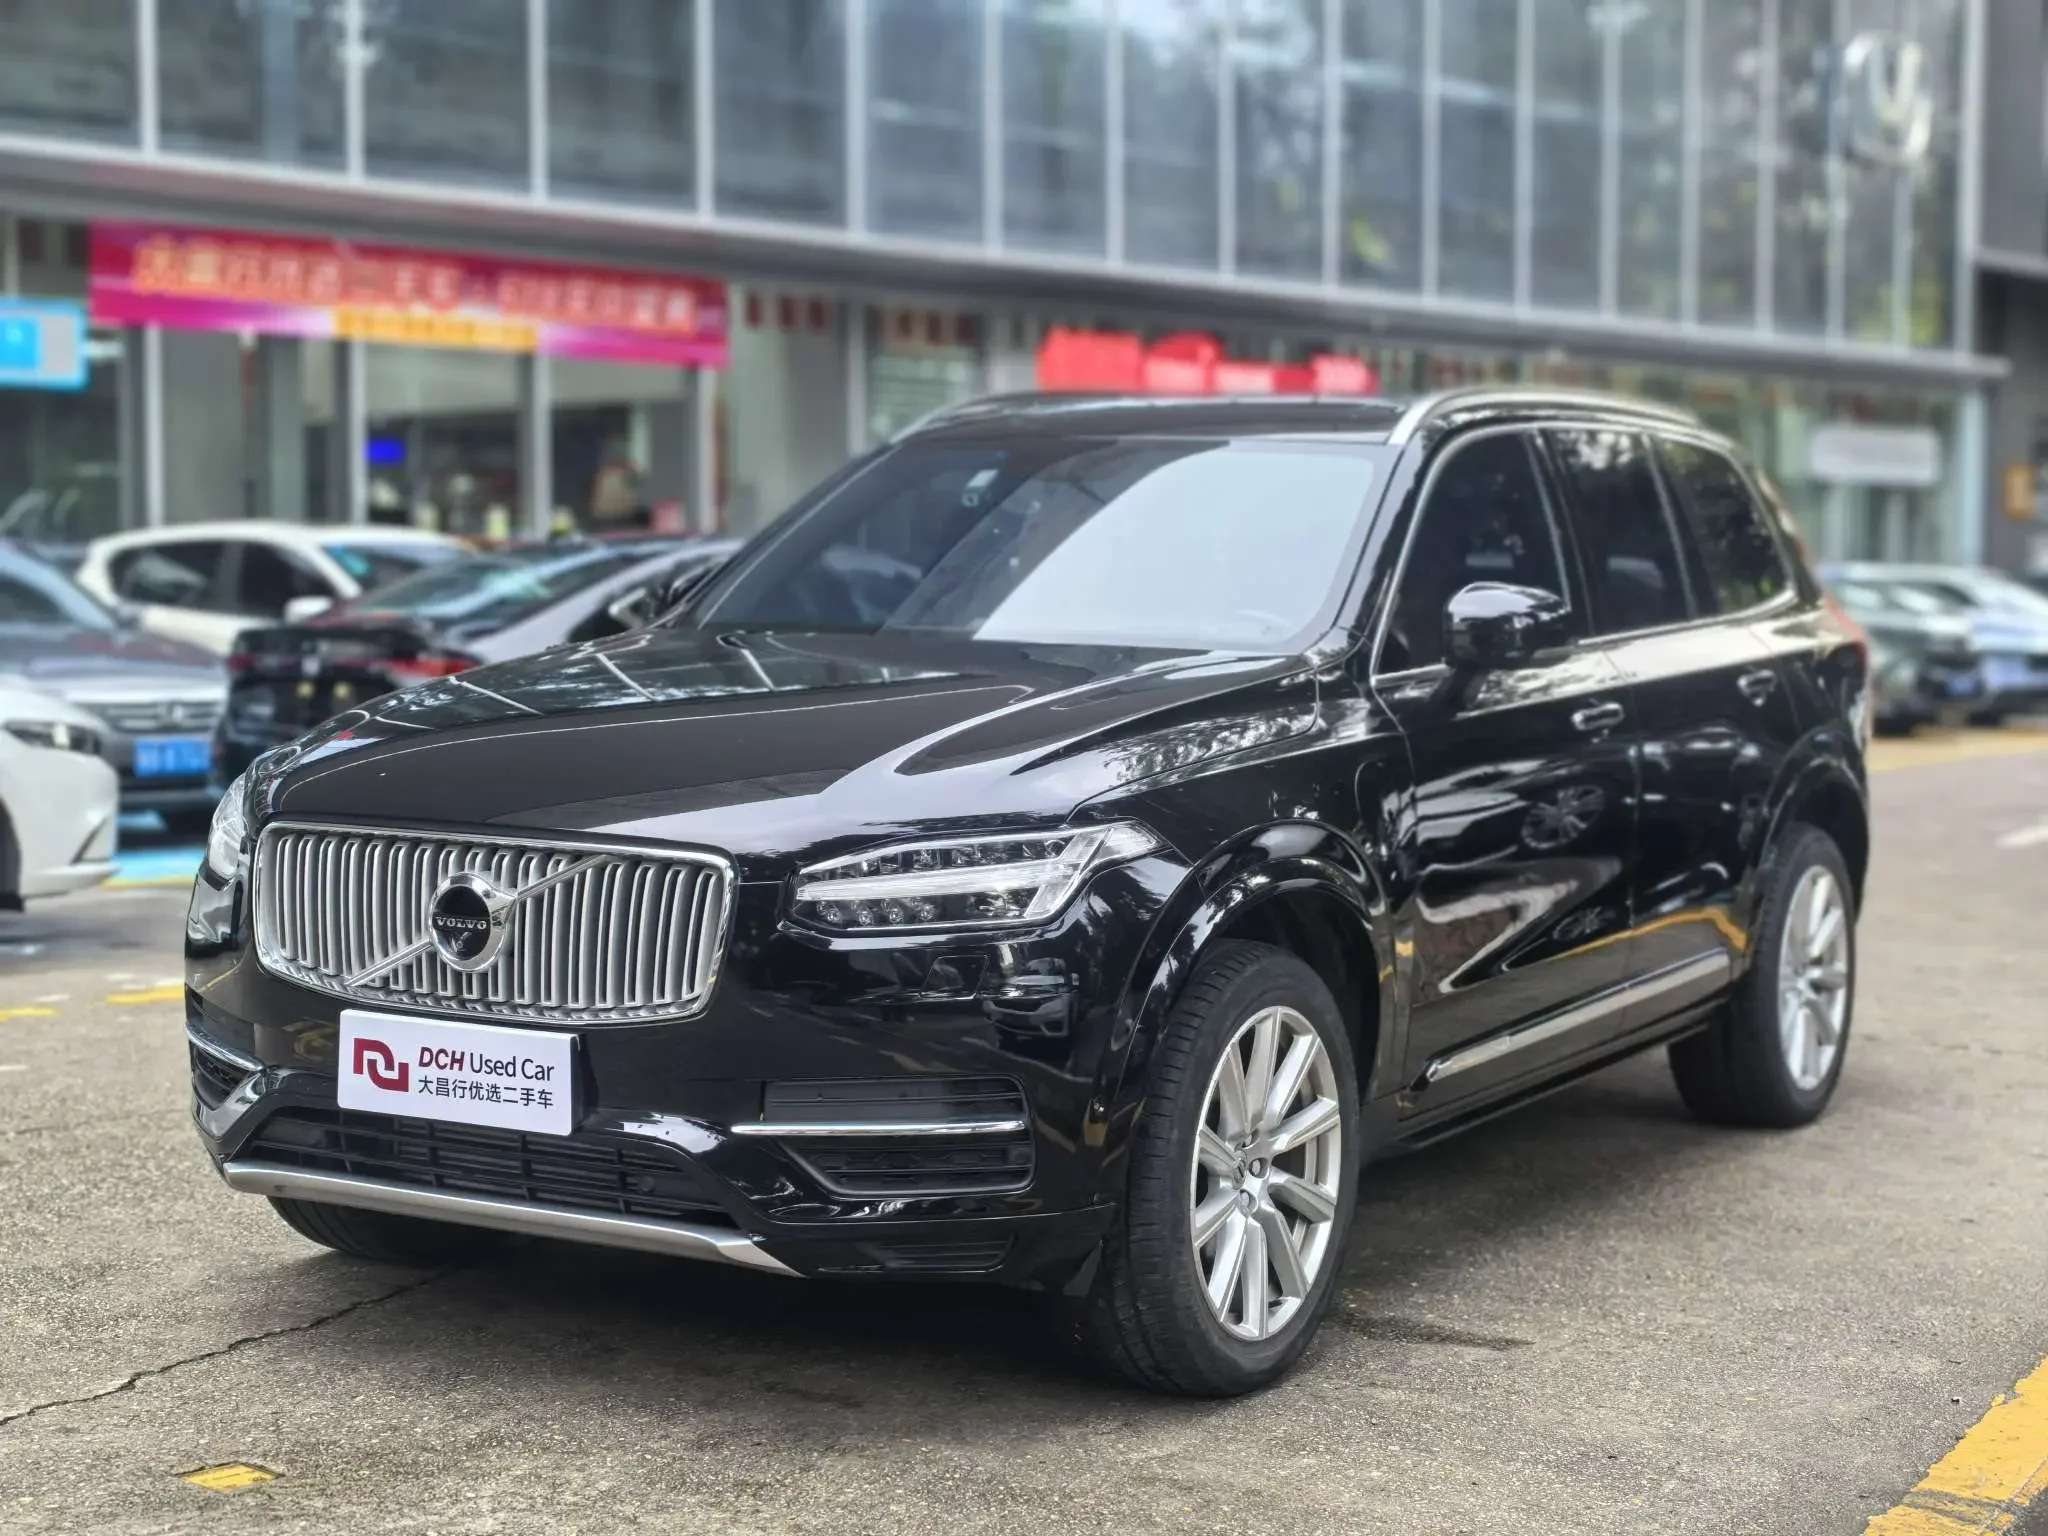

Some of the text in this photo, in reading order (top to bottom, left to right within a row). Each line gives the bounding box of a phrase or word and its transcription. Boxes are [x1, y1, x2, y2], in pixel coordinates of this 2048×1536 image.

[435, 916, 488, 930] VOLVO
[418, 1046, 555, 1081] DCH Used Car
[418, 1076, 554, 1109] 大昌行优选二手车
